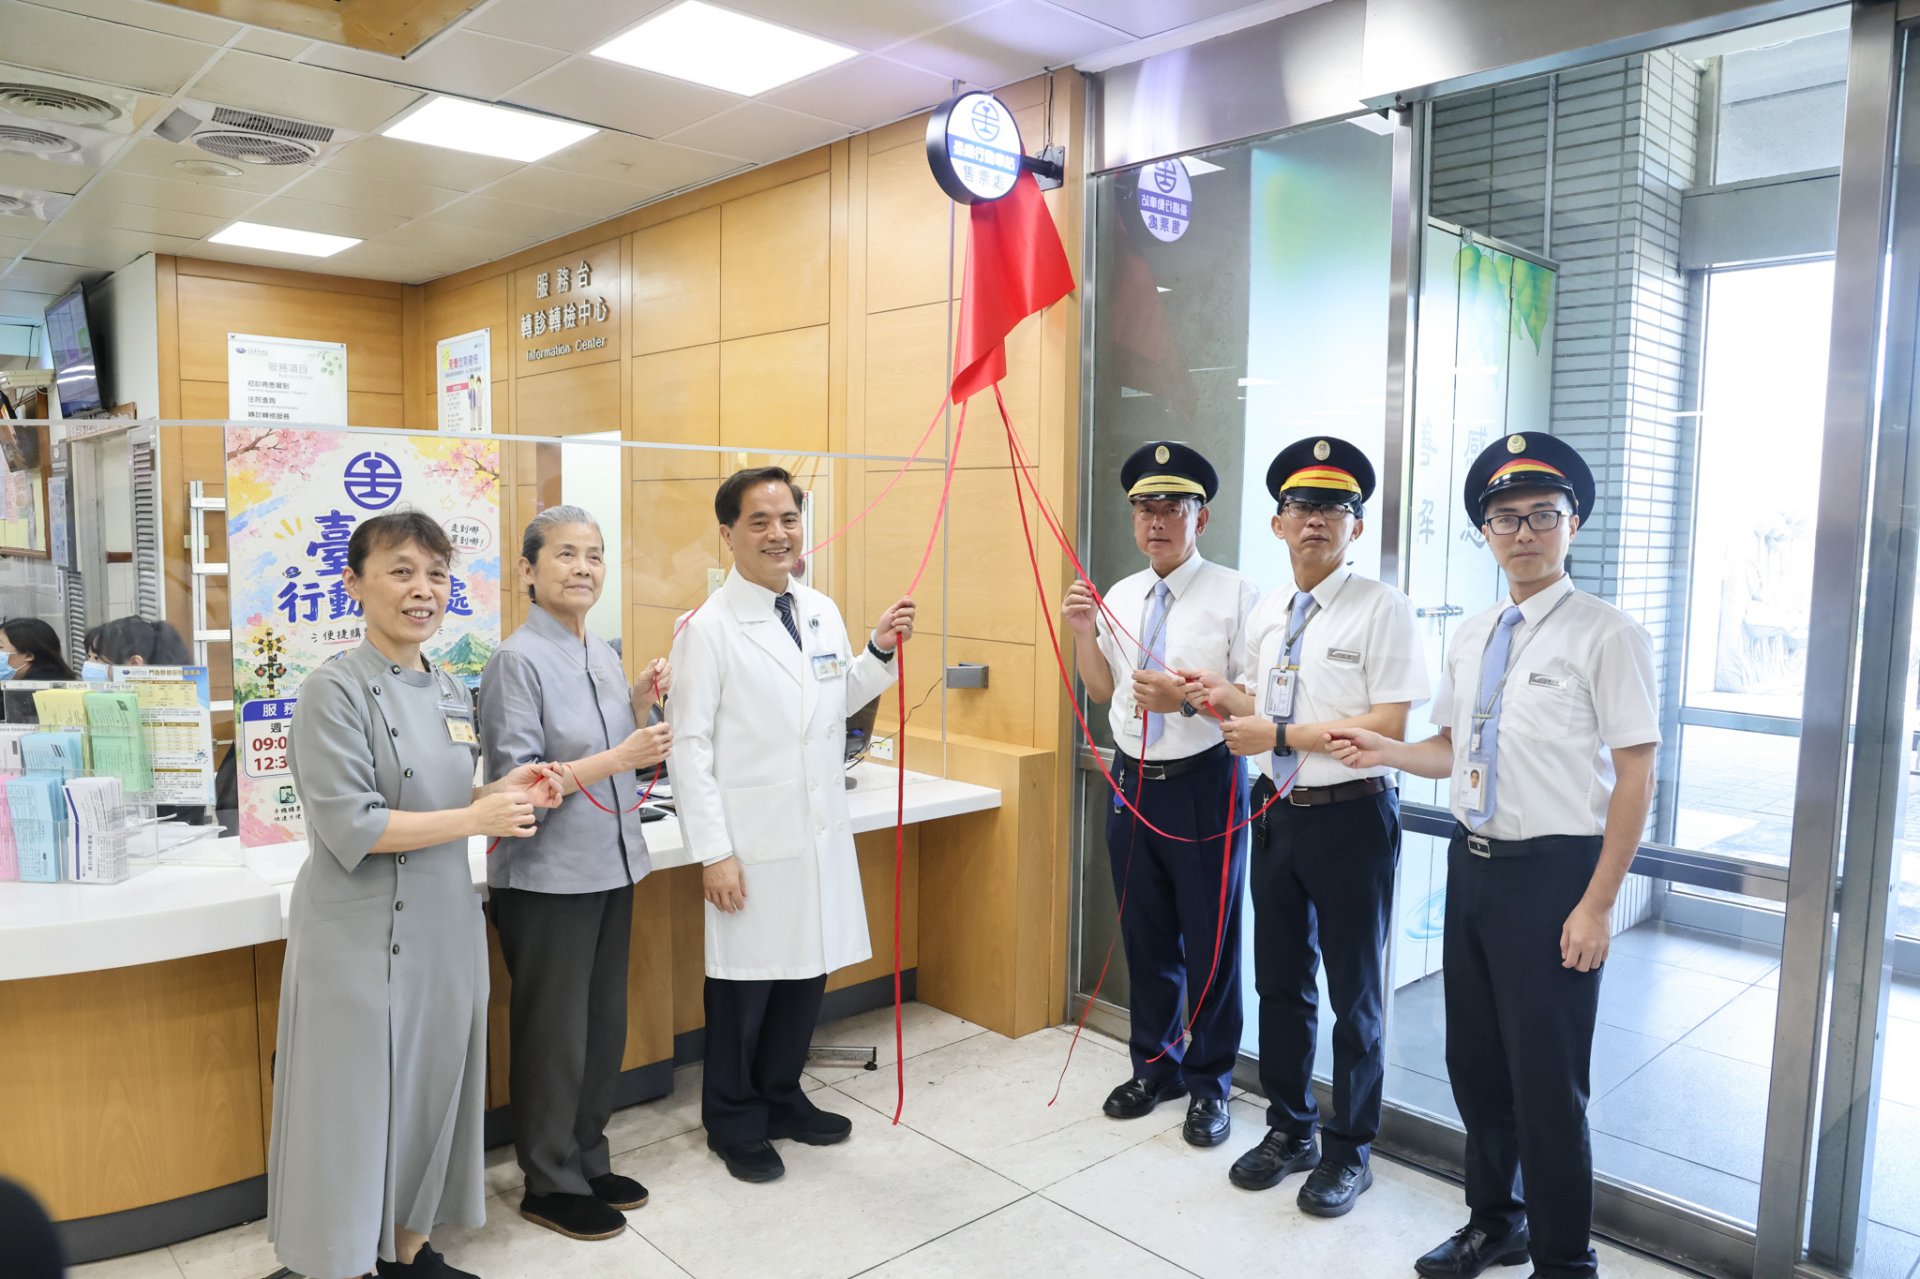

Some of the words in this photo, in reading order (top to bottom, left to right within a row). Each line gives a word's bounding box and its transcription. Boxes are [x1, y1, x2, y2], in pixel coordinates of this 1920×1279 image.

[536, 261, 592, 299] 服務台
[521, 296, 609, 339] 轉診轉檢中心
[527, 344, 572, 361] Information
[575, 337, 606, 352] Center
[451, 523, 479, 534] 走到哪
[323, 628, 367, 641] 便捷購
[262, 702, 297, 717] 服務
